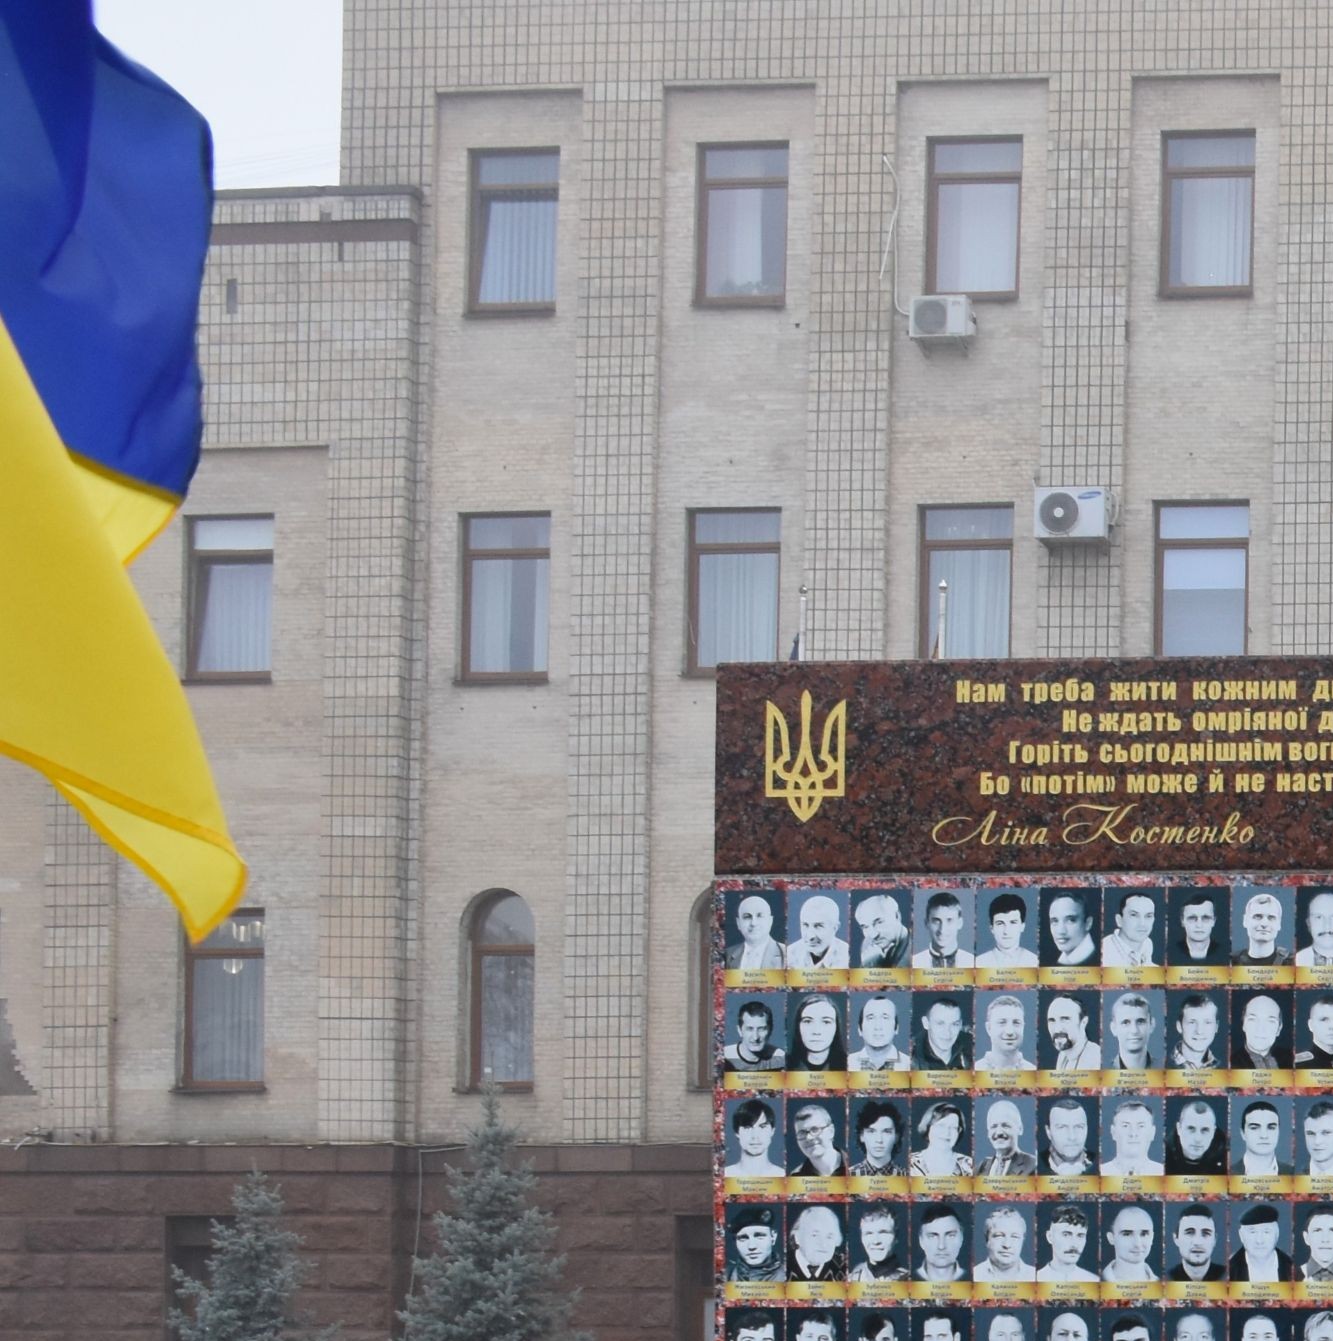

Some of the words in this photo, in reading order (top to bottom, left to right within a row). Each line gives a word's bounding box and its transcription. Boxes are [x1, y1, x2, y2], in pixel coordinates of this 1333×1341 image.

[956, 679, 1006, 704] Нам
[1020, 677, 1095, 704] треба
[1109, 681, 1177, 701] жити
[1192, 679, 1297, 701] кожним
[1062, 709, 1093, 733] Не
[1098, 711, 1182, 734] ждать
[1192, 707, 1308, 734] омріяної
[1008, 740, 1089, 766] Горіть
[1099, 739, 1283, 765] сьогоднішнім
[979, 771, 1010, 796] Бо
[1020, 771, 1116, 795] «потім»
[1126, 773, 1198, 794] може
[1208, 768, 1224, 793] й
[1234, 772, 1266, 793] не
[932, 810, 1048, 847] Ліна
[1062, 804, 1255, 844] Костенко
